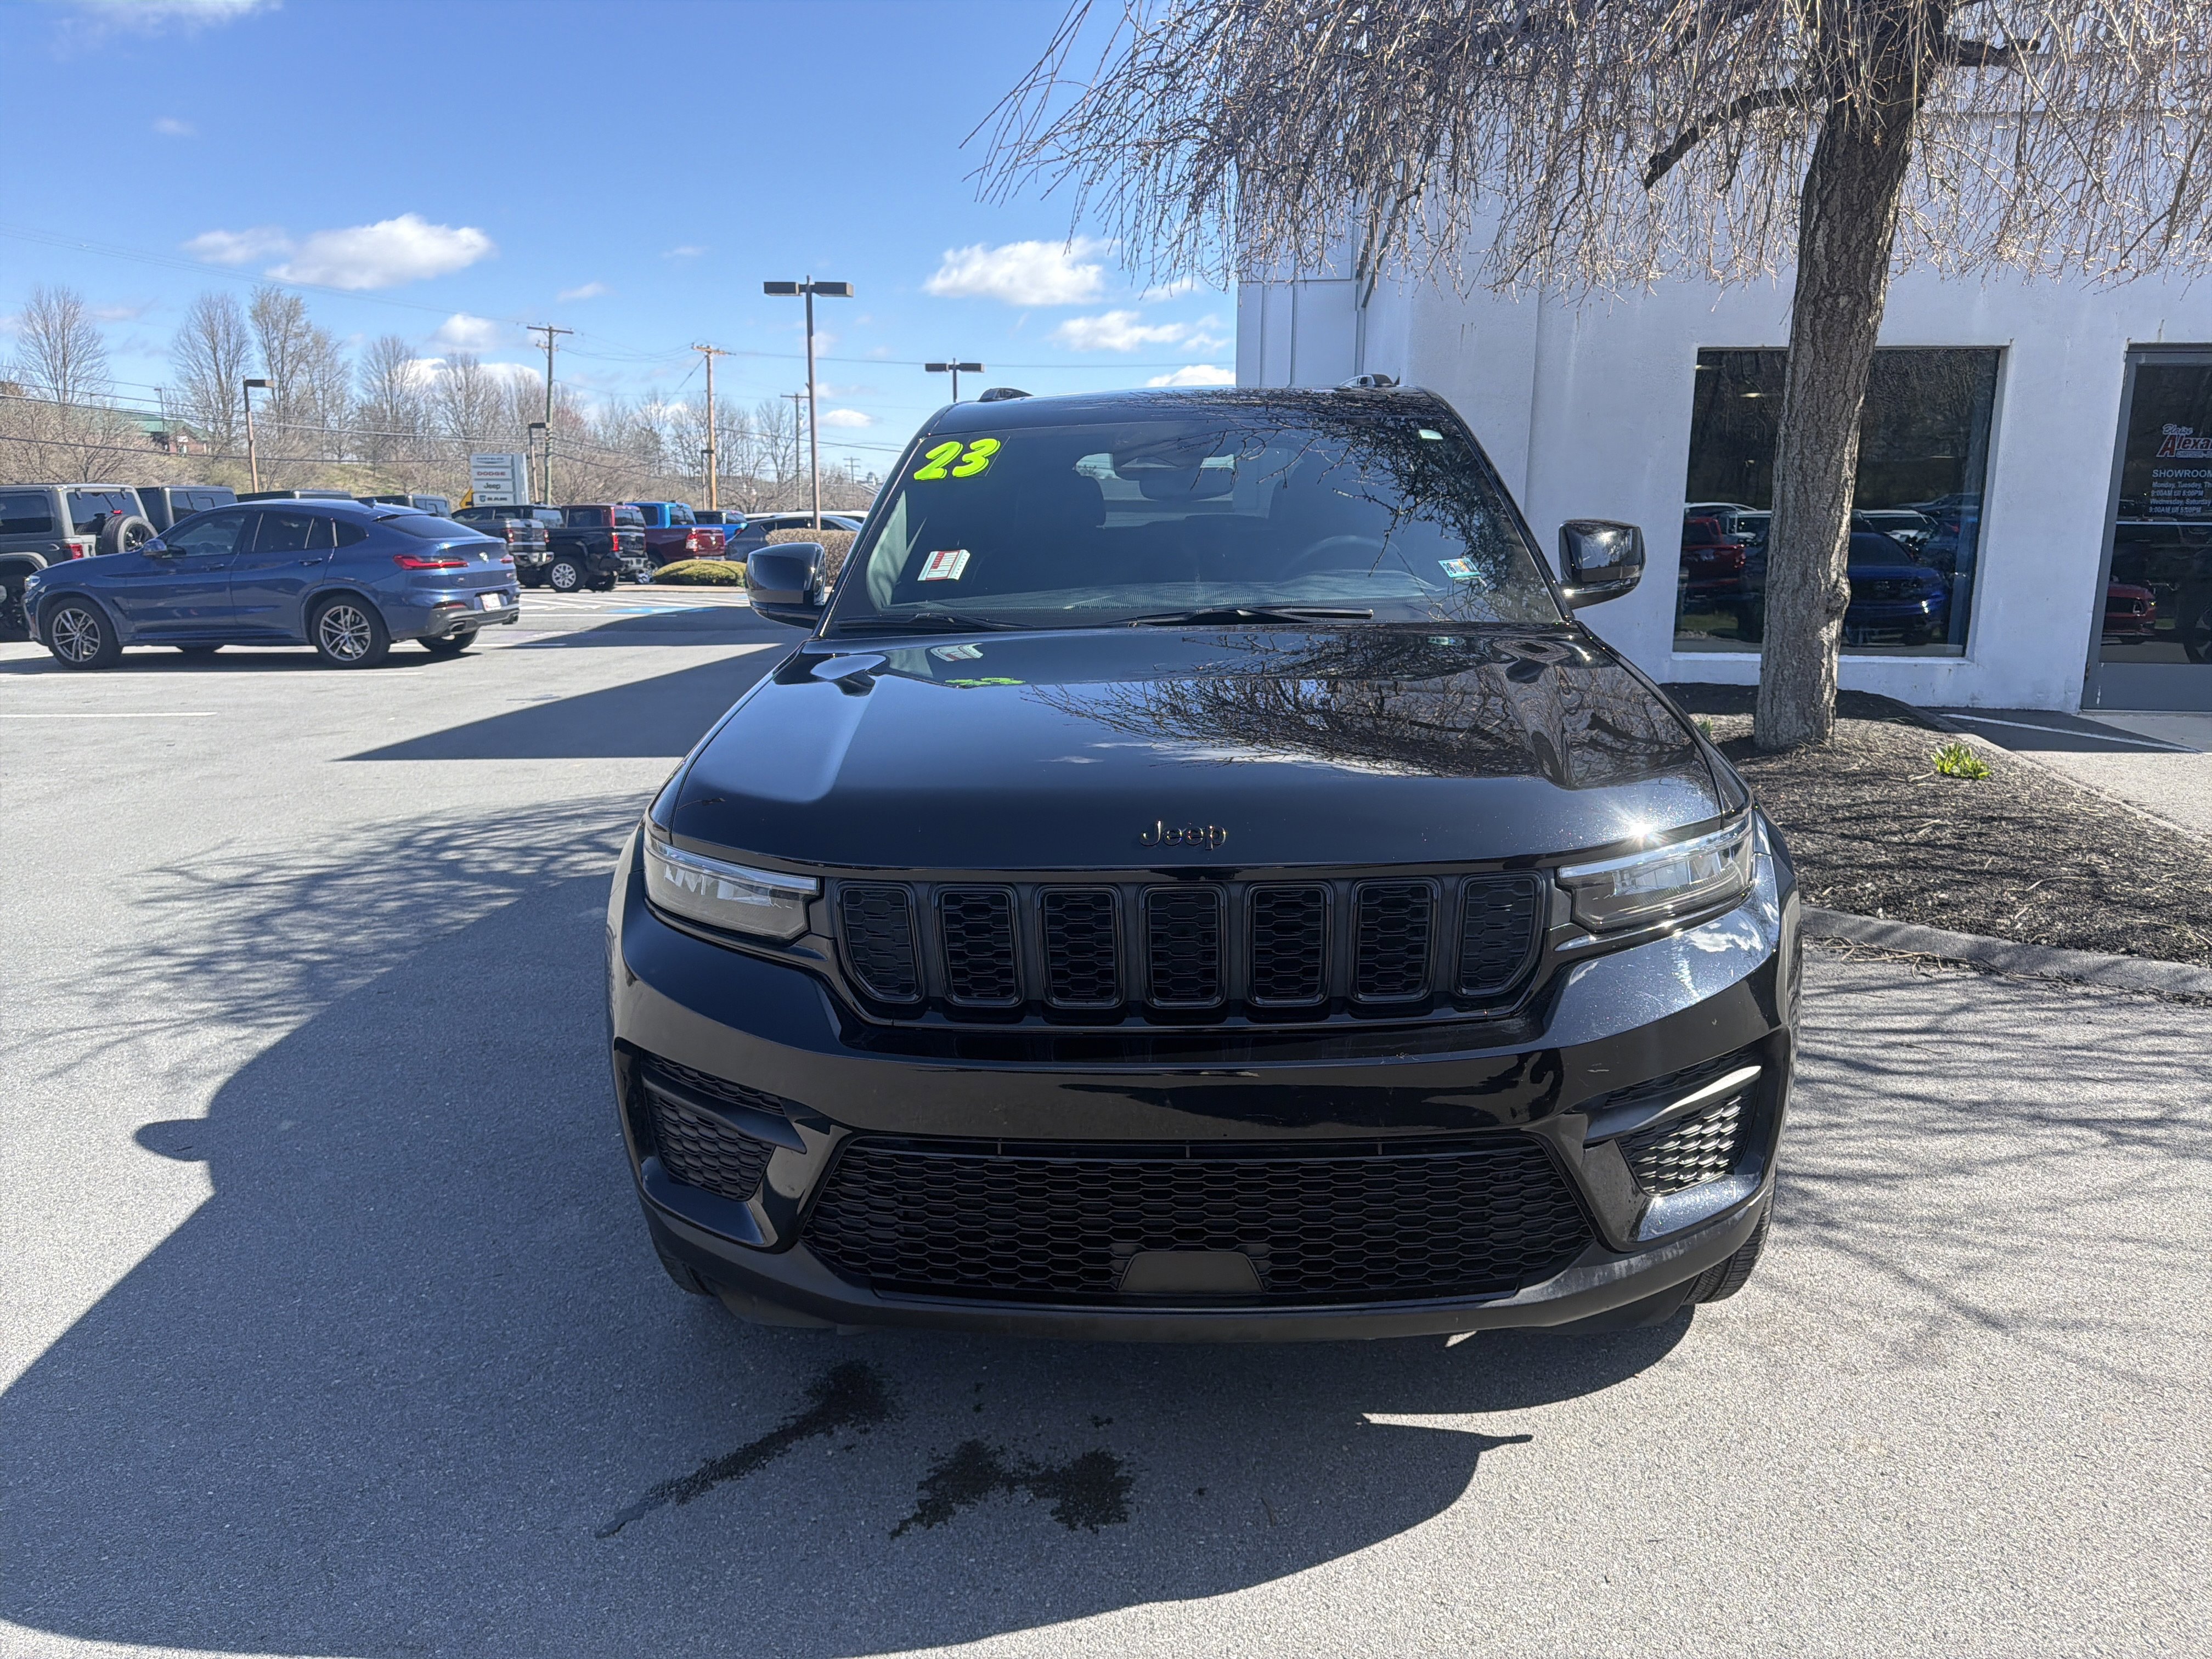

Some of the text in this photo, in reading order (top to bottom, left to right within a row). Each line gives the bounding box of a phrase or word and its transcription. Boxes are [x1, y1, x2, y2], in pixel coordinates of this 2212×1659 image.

[913, 438, 1001, 481] 23
[2156, 434, 2212, 457] Alexa
[1139, 820, 1227, 851] Jeep
